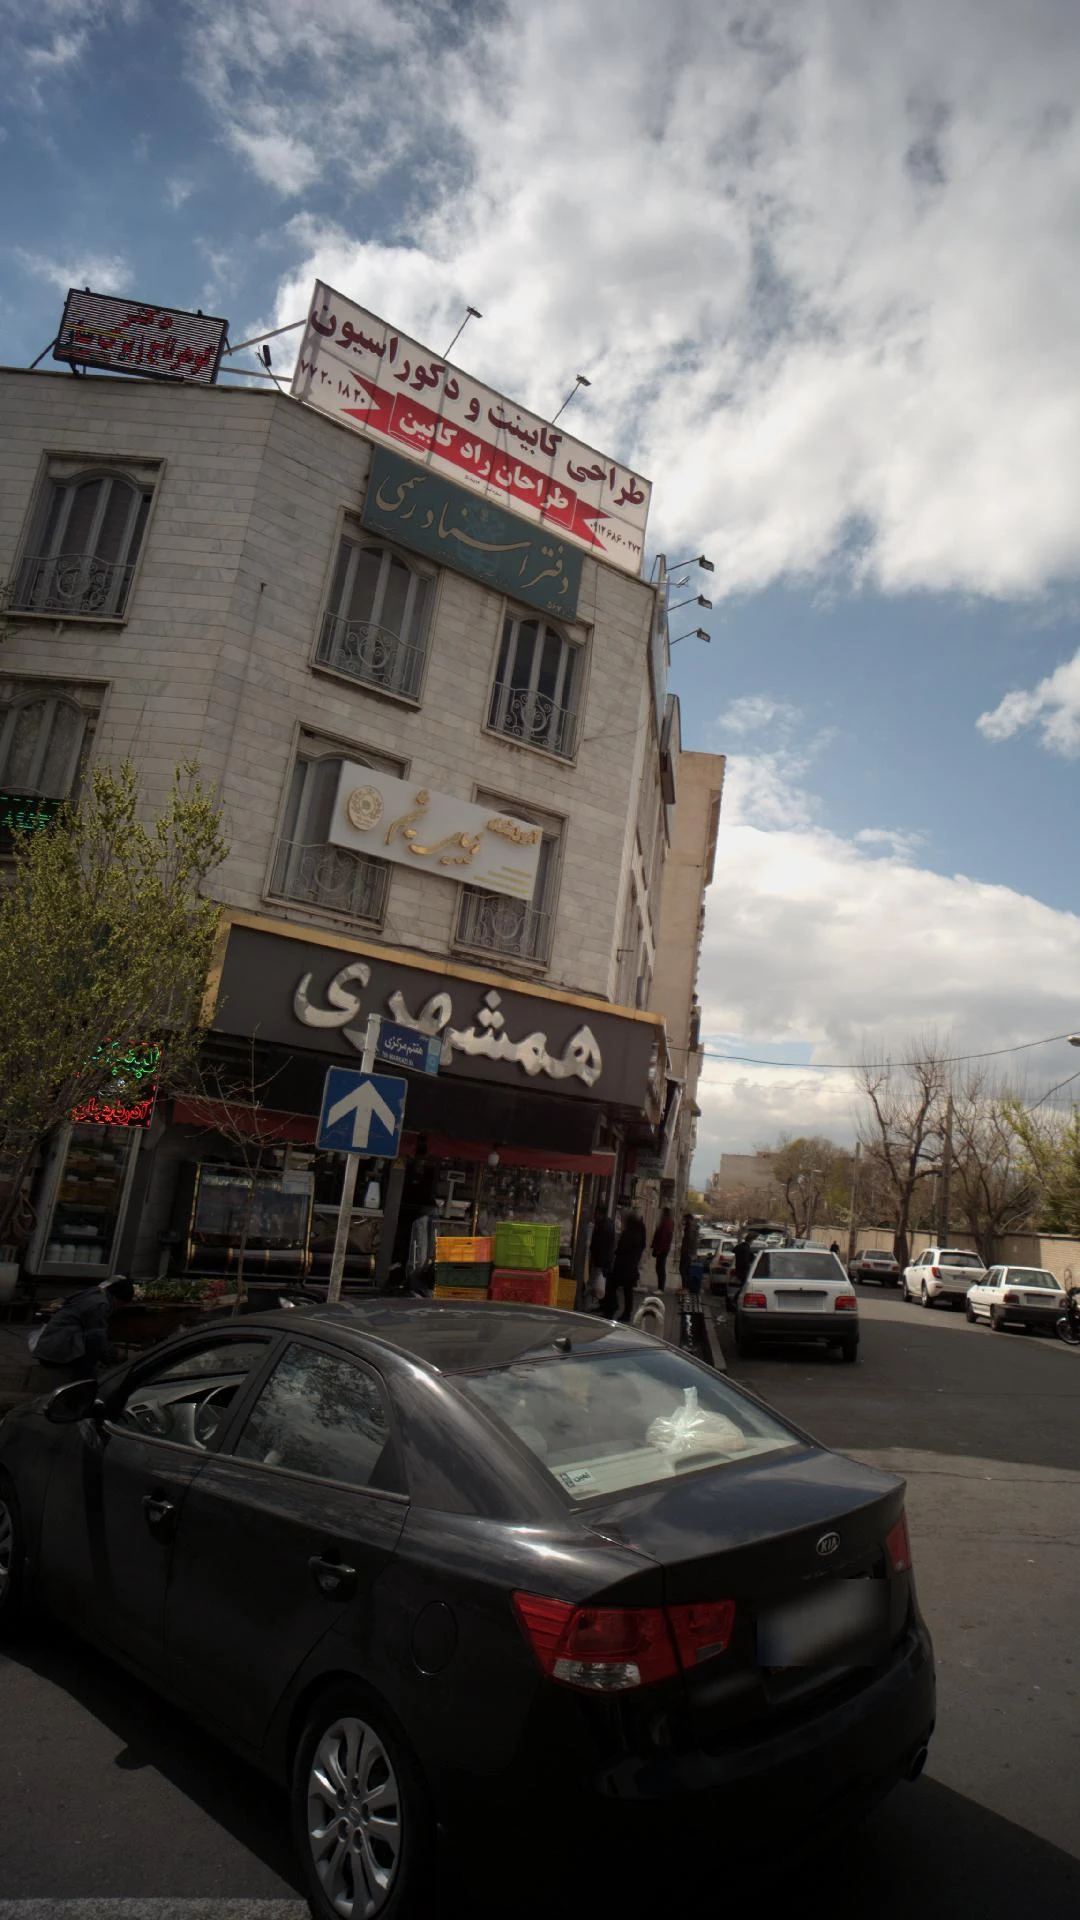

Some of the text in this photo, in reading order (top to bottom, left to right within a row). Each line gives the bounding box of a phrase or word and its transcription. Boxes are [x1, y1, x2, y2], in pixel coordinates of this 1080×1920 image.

[310, 303, 645, 506] طراحی کابینت و دکوراسیون
[399, 412, 457, 447] کابین
[375, 473, 428, 520] رسمی
[495, 463, 569, 510] طراحان
[419, 500, 533, 577] اسناد
[519, 544, 569, 595] دفتر
[820, 1536, 838, 1553] KIA
